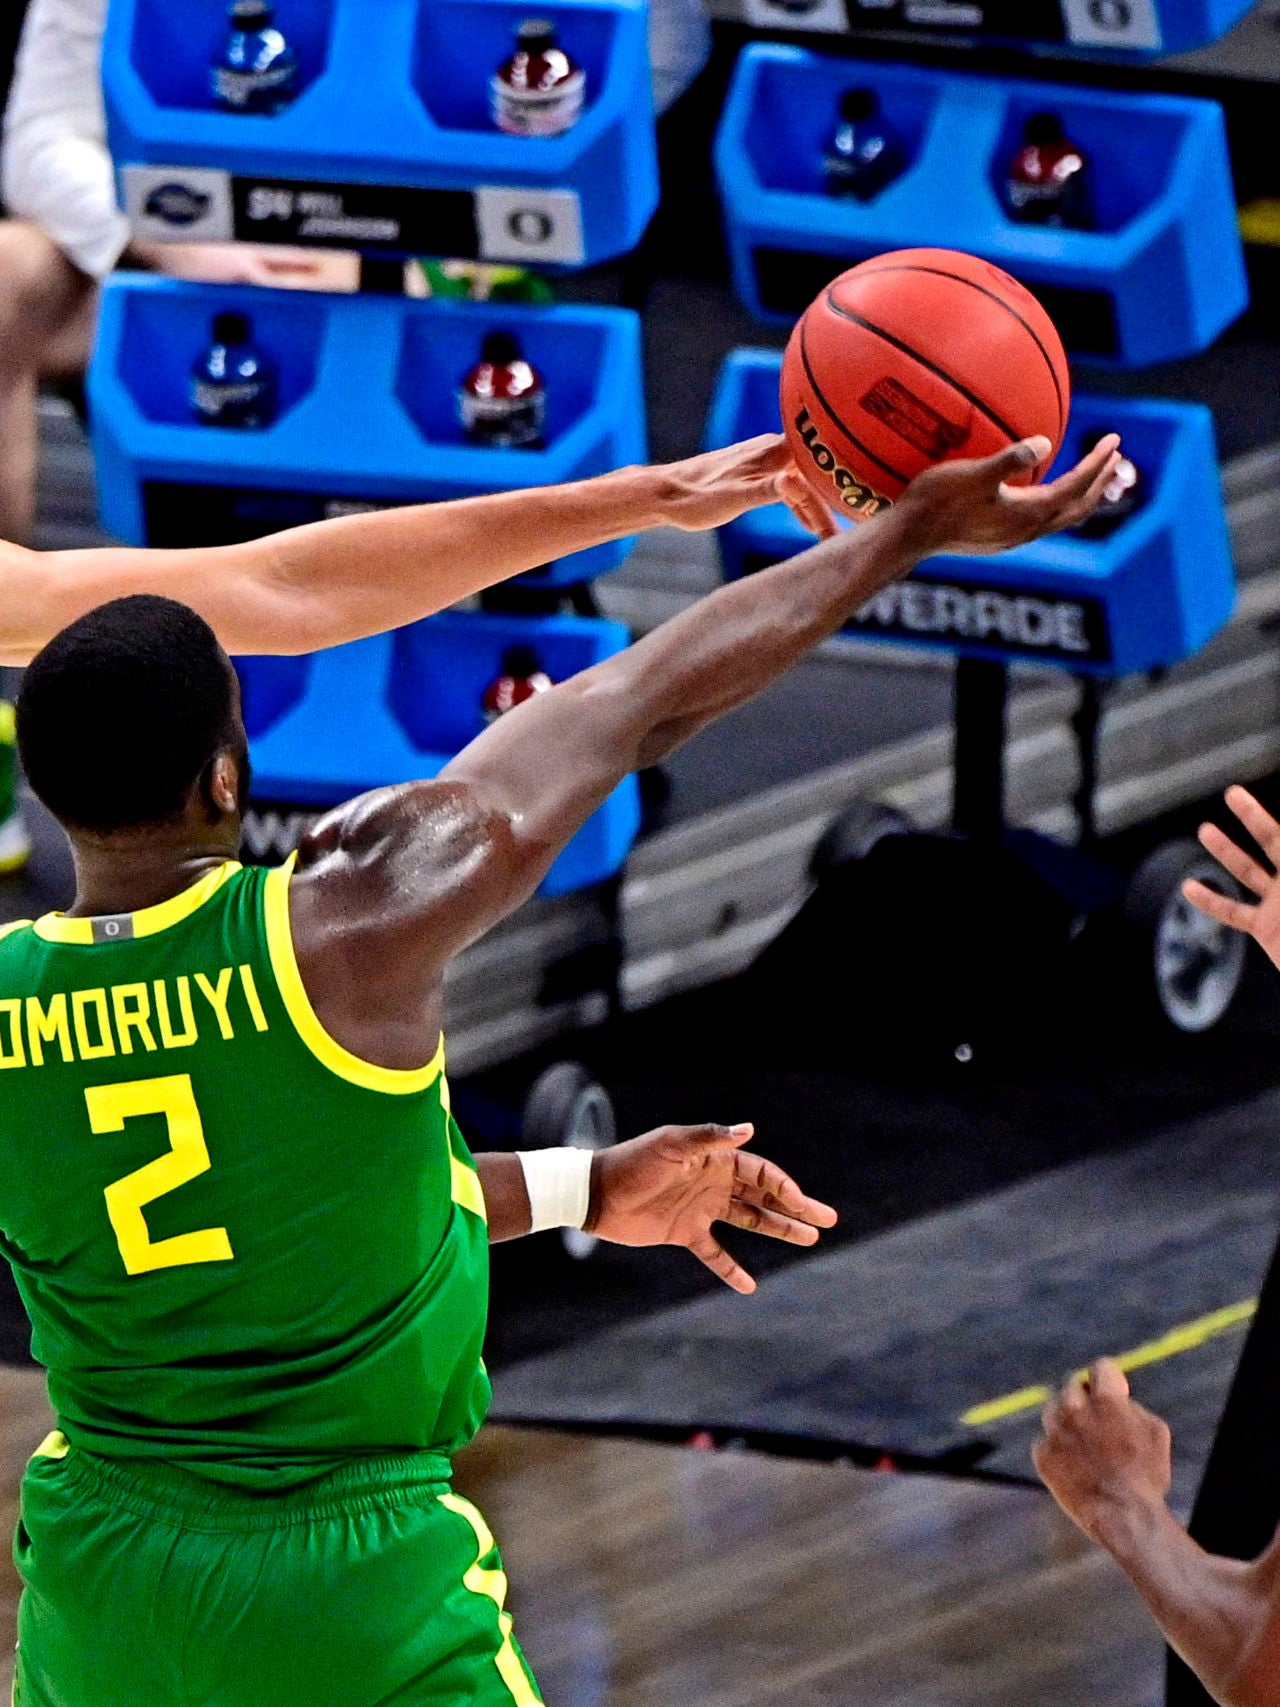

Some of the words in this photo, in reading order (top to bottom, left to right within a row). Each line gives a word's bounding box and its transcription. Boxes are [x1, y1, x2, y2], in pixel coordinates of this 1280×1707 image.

[795, 405, 893, 514] ilson
[852, 580, 1091, 651] WERADE
[84, 1073, 235, 1276] 2
